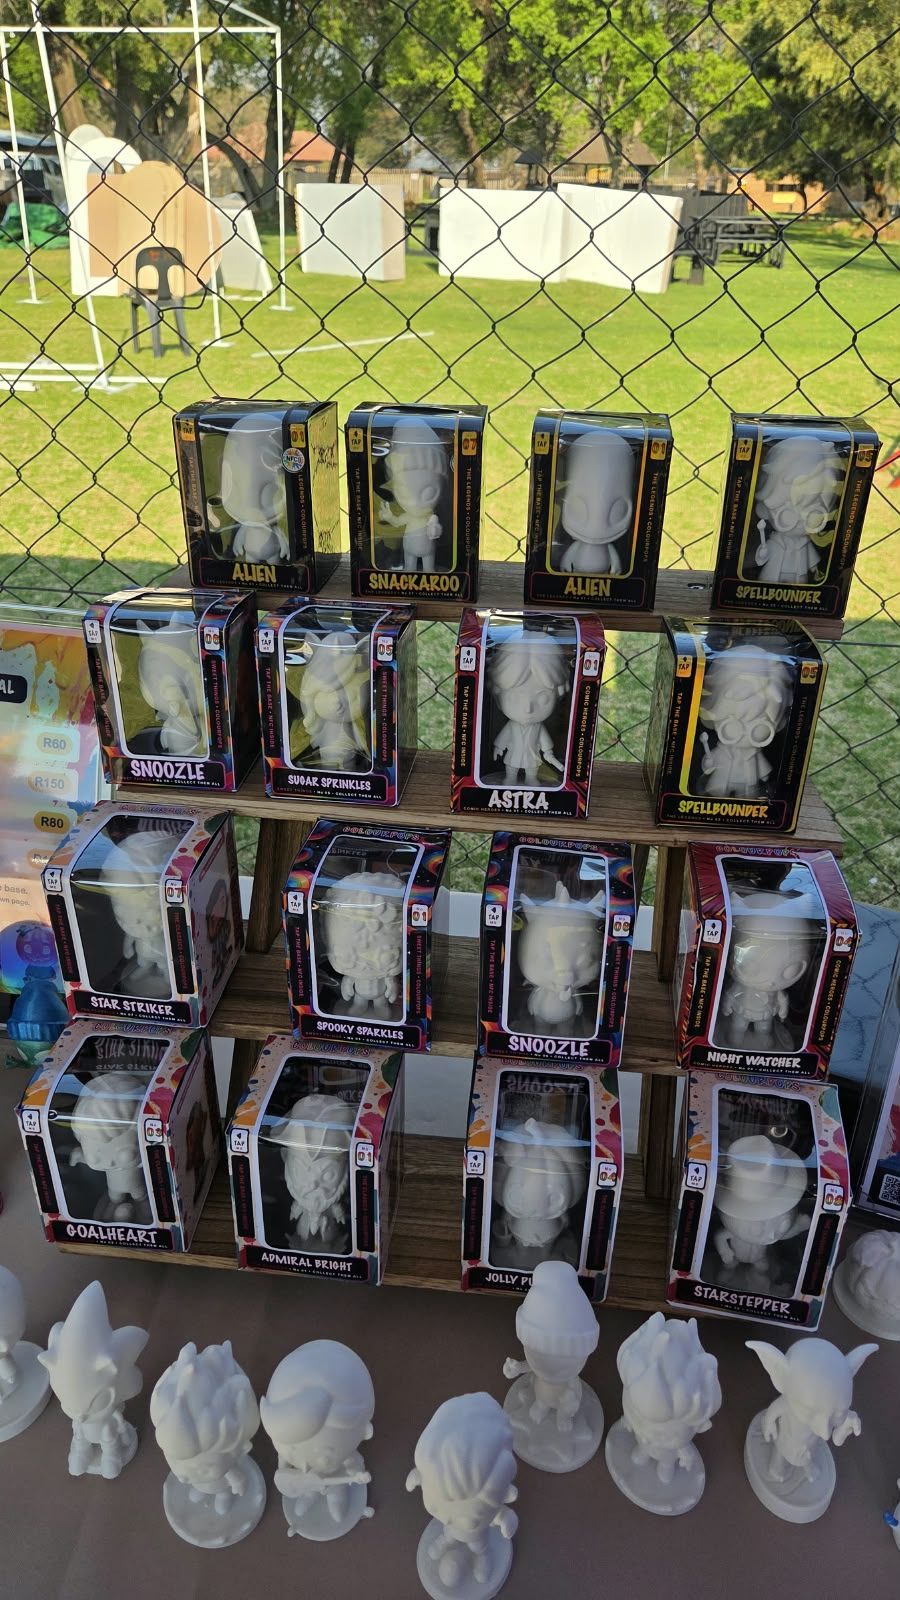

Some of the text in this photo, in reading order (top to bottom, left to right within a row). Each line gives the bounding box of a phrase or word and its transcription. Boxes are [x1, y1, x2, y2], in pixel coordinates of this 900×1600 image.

[232, 562, 277, 584] ALIEN
[368, 573, 460, 593] SNACKAROO
[564, 578, 612, 597] ALIEN
[736, 586, 822, 604] SPELLBOUNDER
[378, 643, 393, 656] 05
[584, 659, 598, 671] 01
[802, 666, 818, 679] 05
[43, 737, 66, 750] R60
[575, 737, 584, 777] COLOURPOPS
[130, 760, 205, 780] SNOOZLE
[35, 776, 64, 790] R150
[288, 774, 320, 787] SUGAR
[321, 778, 372, 791] SPRINKLES
[488, 790, 549, 810] ASTRA
[678, 800, 768, 818] SPELLBOUNDER
[41, 816, 64, 829] R80
[5, 884, 28, 894] base.
[167, 886, 181, 898] 07
[413, 911, 427, 922] 01
[91, 996, 122, 1010] STAR
[122, 1001, 175, 1016] STRIKER
[316, 1021, 354, 1035] SPOOKY
[356, 1026, 404, 1040] SPARKLES
[508, 1035, 590, 1056] SNOOZLE
[707, 1051, 801, 1069] NIGHT WATCHER
[357, 1151, 372, 1162] 01
[66, 1224, 158, 1244] GOALHEART
[261, 1252, 353, 1272] ADMIRAL BRIGHT
[485, 1273, 533, 1286] JOLLY PU
[694, 1285, 791, 1314] STARSTEPPER
